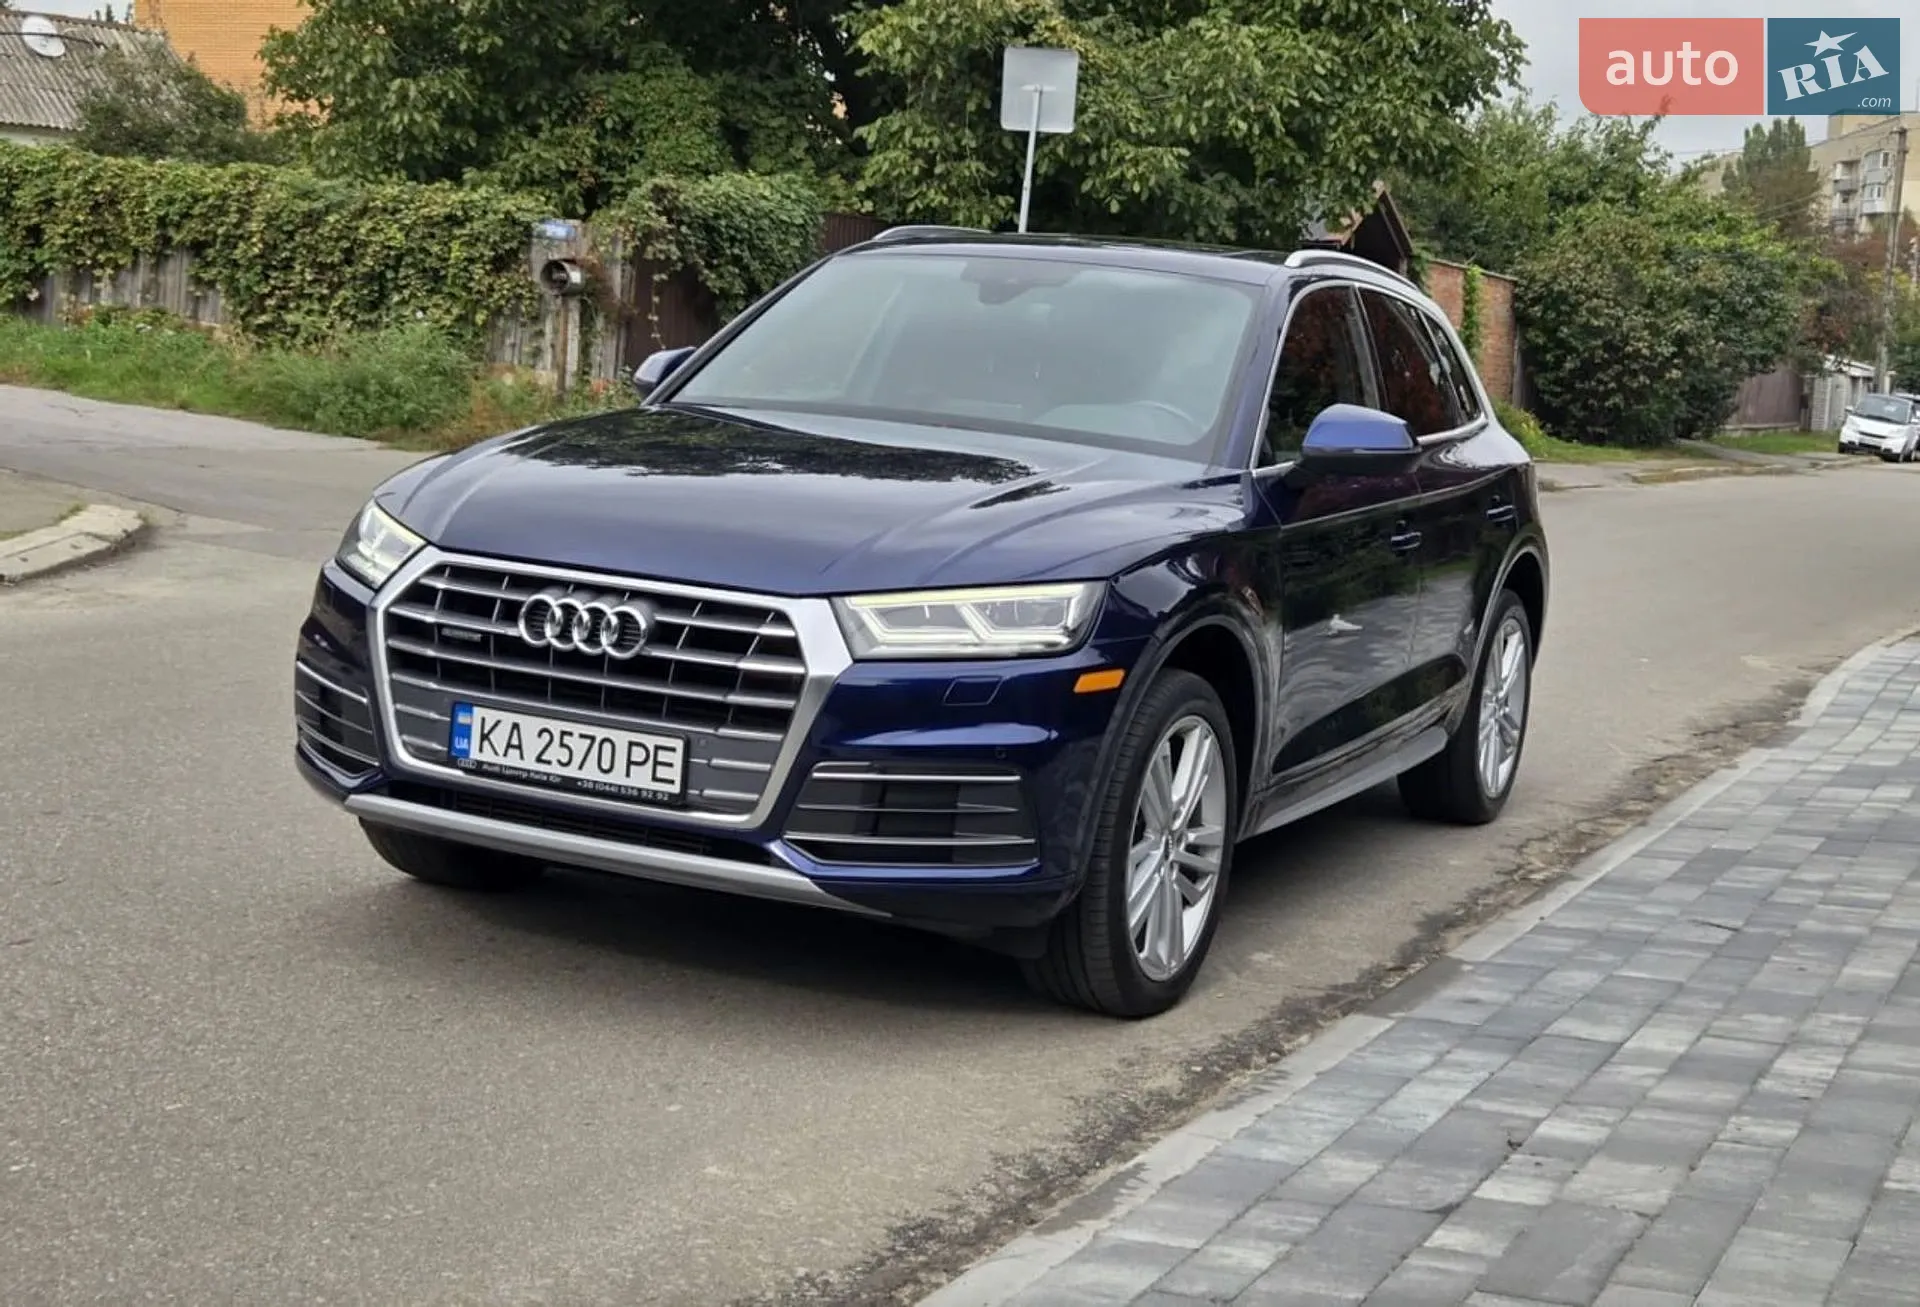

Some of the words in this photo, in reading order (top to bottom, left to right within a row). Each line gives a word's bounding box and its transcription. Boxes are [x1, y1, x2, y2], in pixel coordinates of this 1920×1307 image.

[454, 735, 468, 750] UA
[478, 716, 525, 761] KA
[535, 727, 616, 775] 2570
[625, 740, 677, 785] PE
